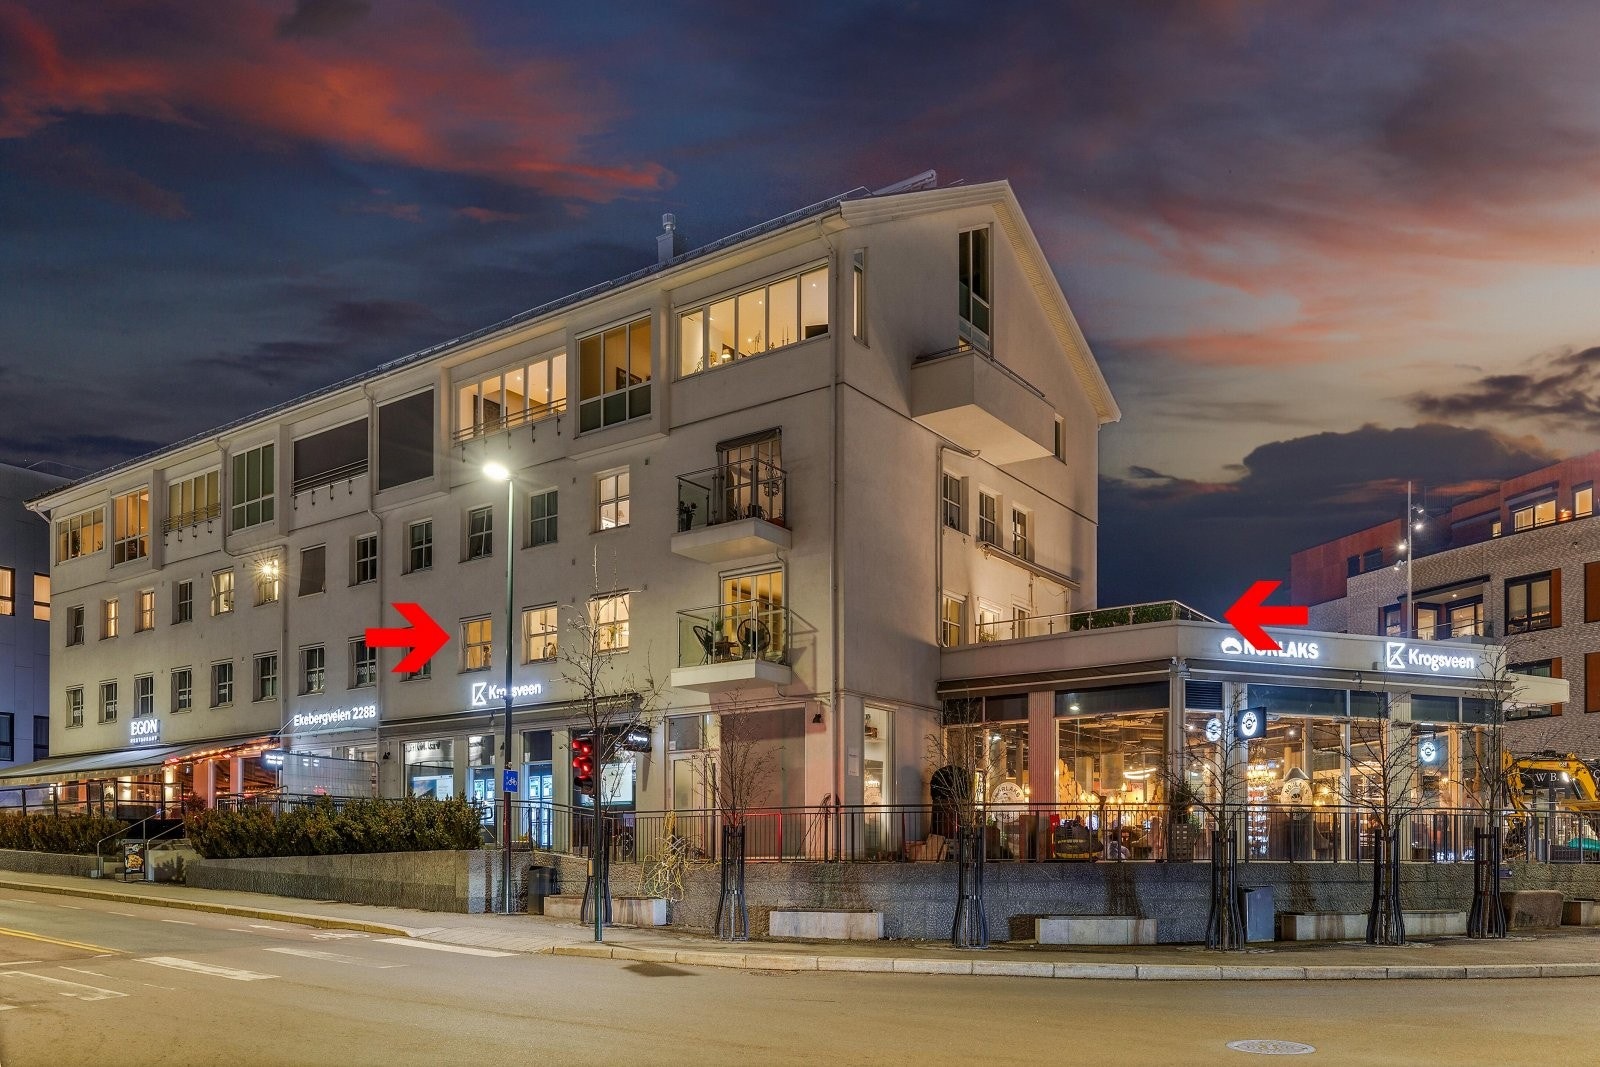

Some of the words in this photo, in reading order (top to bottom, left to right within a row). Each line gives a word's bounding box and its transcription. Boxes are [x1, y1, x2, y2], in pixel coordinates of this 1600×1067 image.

[1244, 638, 1319, 659] NLAKS
[1408, 648, 1475, 672] Krogsveen
[293, 708, 351, 727] Ekebergveien
[352, 705, 376, 720] 228B
[130, 719, 158, 736] EGON
